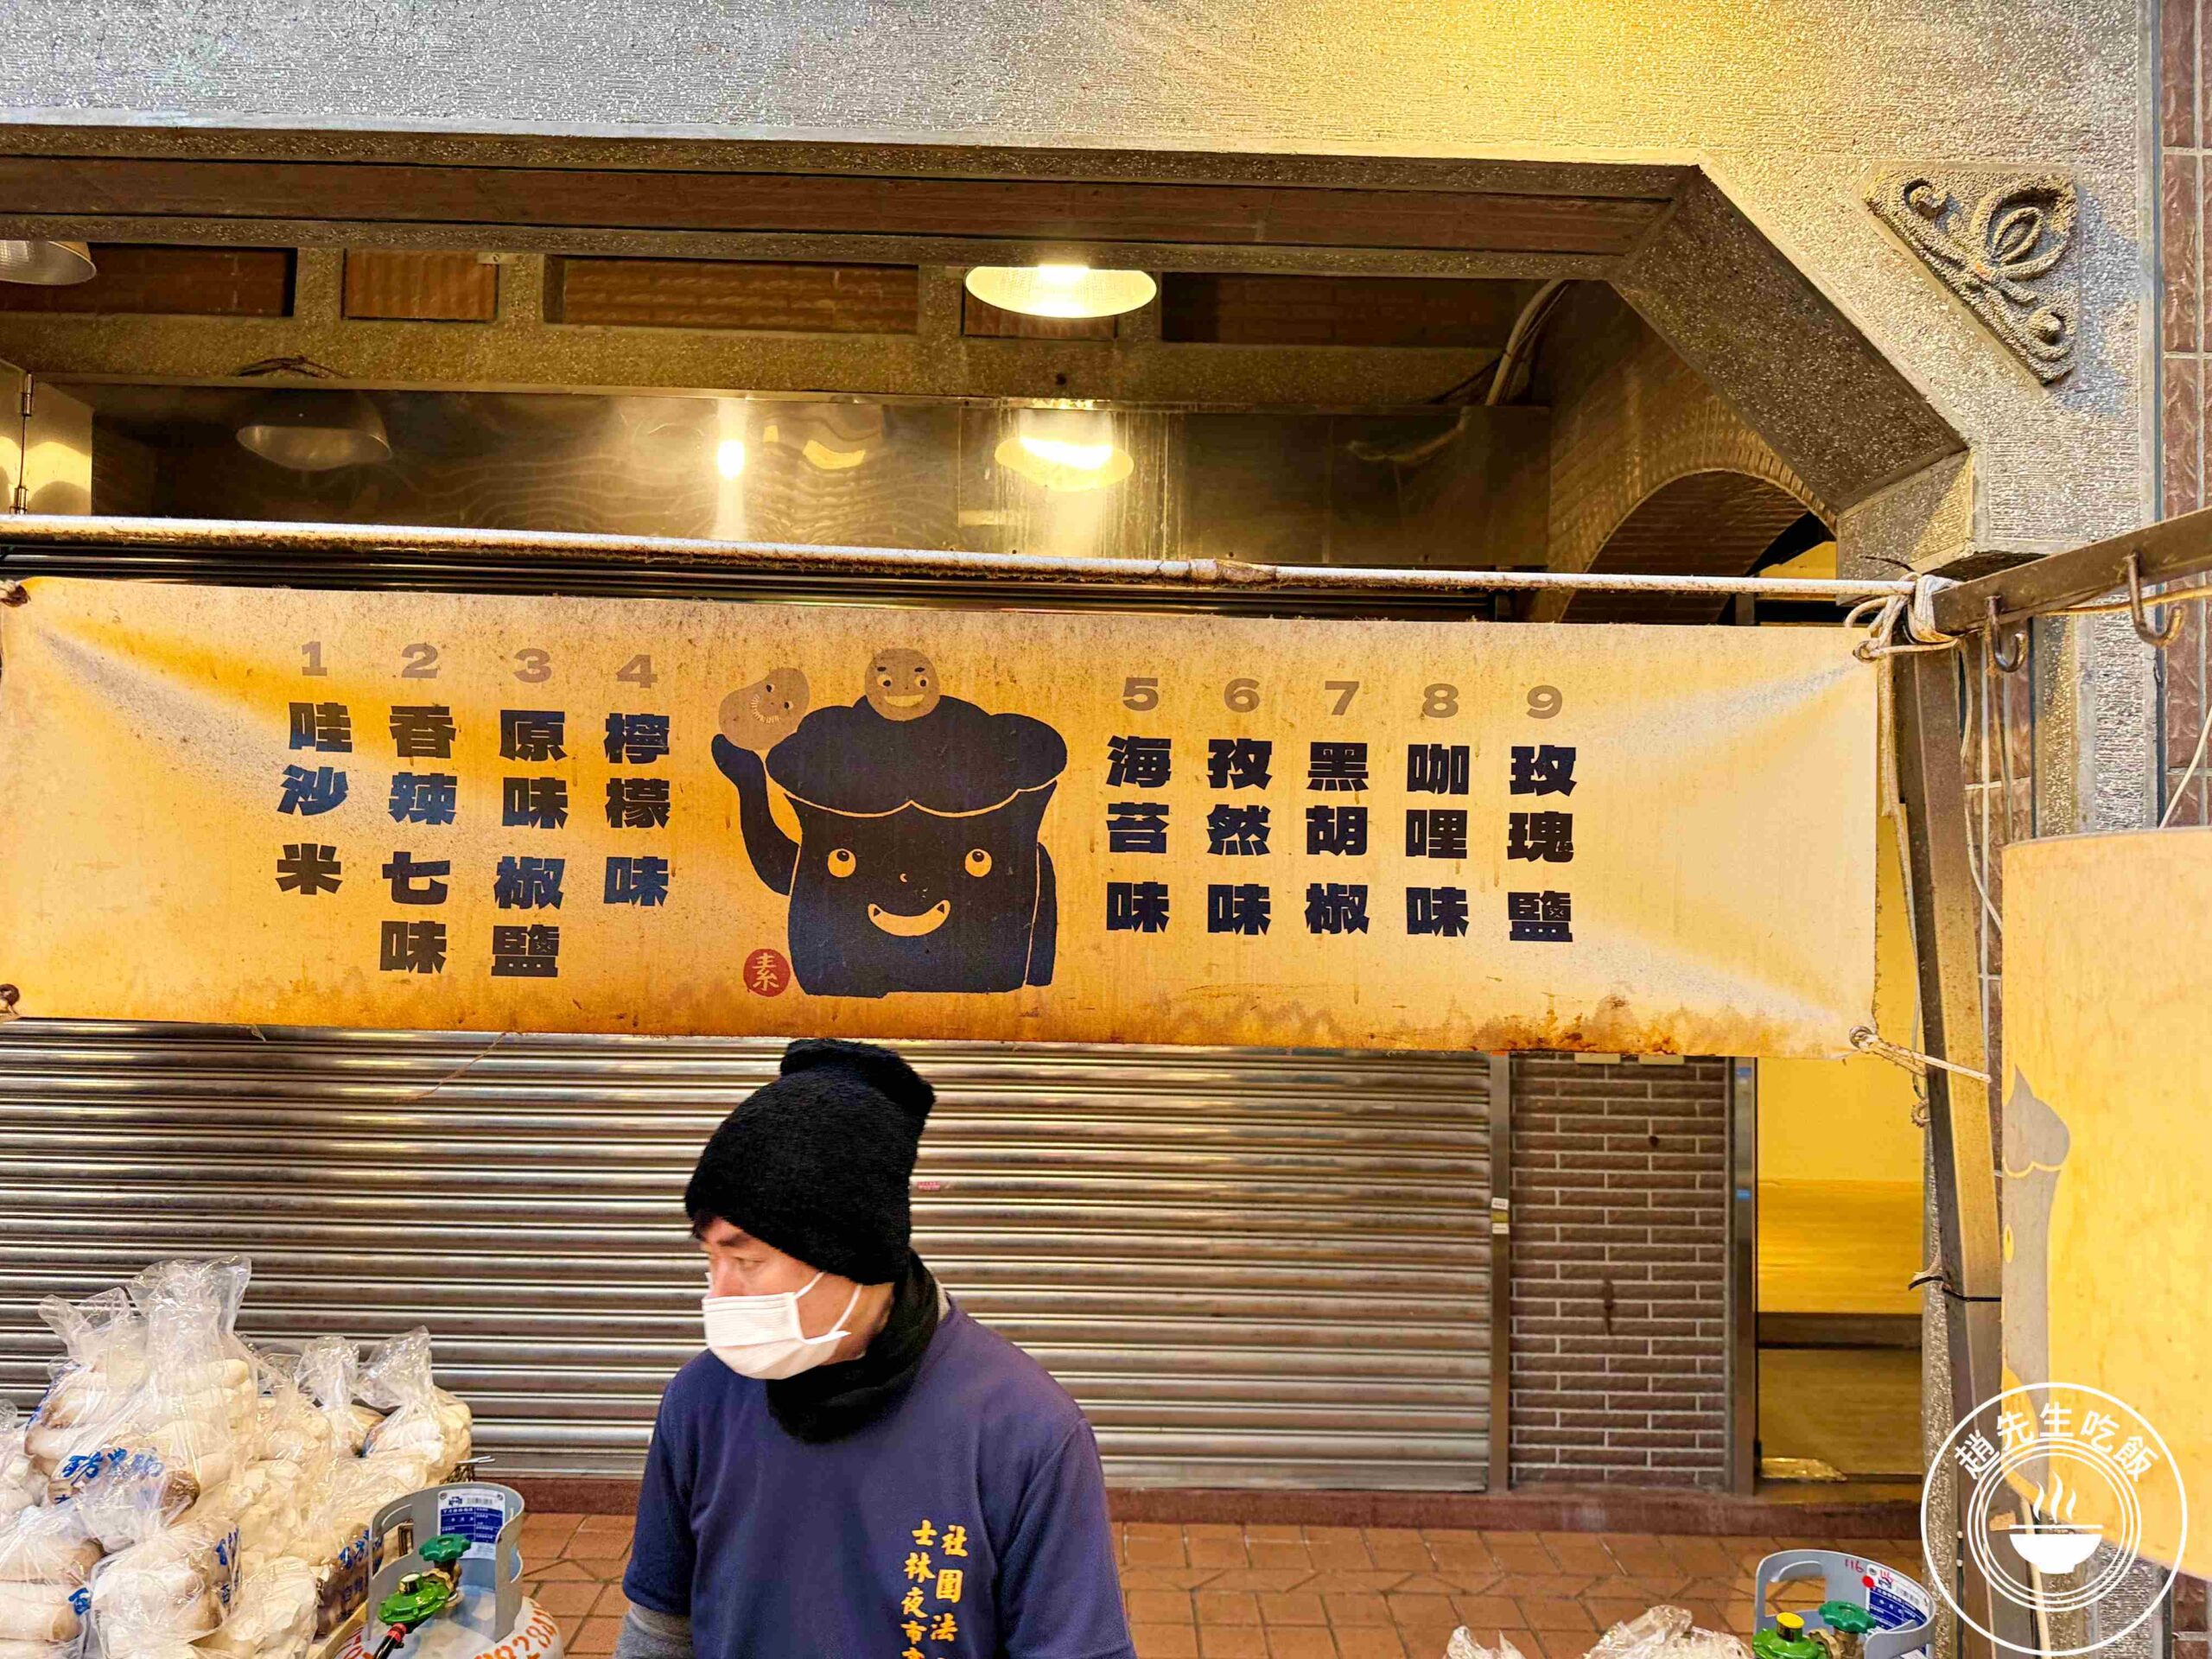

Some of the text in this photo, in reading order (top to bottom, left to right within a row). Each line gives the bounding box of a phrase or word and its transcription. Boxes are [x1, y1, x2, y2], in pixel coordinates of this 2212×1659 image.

[302, 641, 327, 677] 1
[401, 643, 439, 678] 2
[513, 648, 552, 683] 3
[617, 654, 658, 689] 4
[1122, 677, 1159, 711] 5
[1224, 678, 1261, 712] 6
[1324, 681, 1360, 715] 7
[1423, 683, 1459, 718] 8
[1526, 685, 1563, 719] 9
[276, 702, 353, 895] 哇沙米
[379, 703, 458, 974] 香辣七味
[491, 709, 568, 977] 原味椒鹽
[603, 712, 670, 907] 檸檬味
[1105, 735, 1172, 933] 海苔味
[1206, 738, 1273, 936] 孜然味
[1305, 741, 1370, 935] 黑胡椒
[1406, 743, 1470, 938] 咖哩味
[1507, 745, 1577, 942] 玫瑰鹽
[929, 1524, 969, 1658] 社團法
